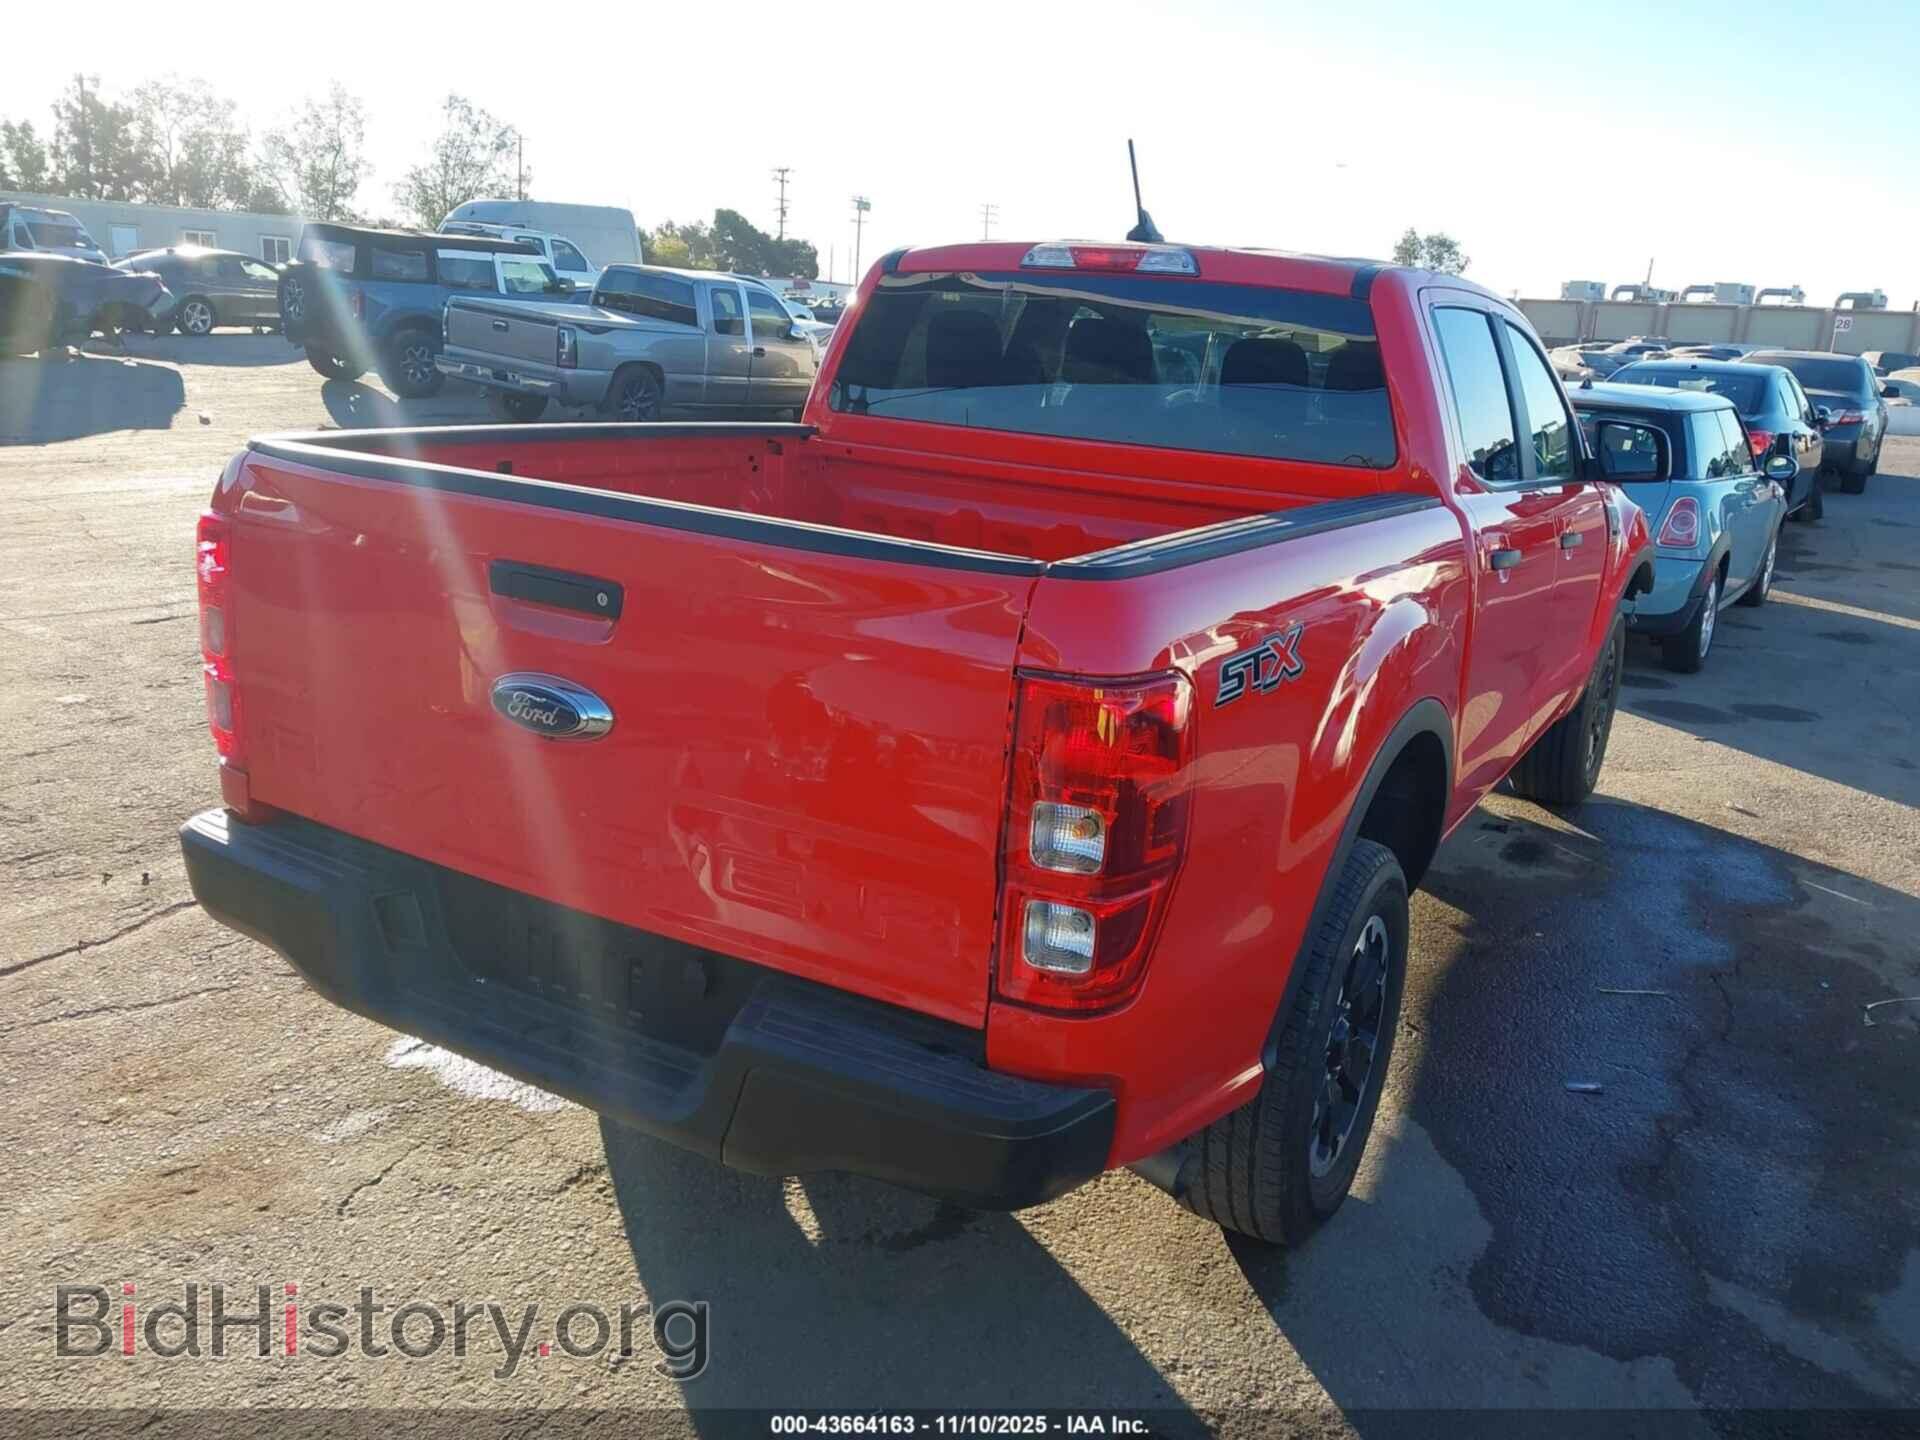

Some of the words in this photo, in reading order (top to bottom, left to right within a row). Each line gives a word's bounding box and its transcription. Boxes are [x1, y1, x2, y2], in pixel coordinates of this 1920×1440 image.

[1836, 319, 1851, 329] 28
[1214, 624, 1305, 709] STX
[507, 690, 561, 726] Ford
